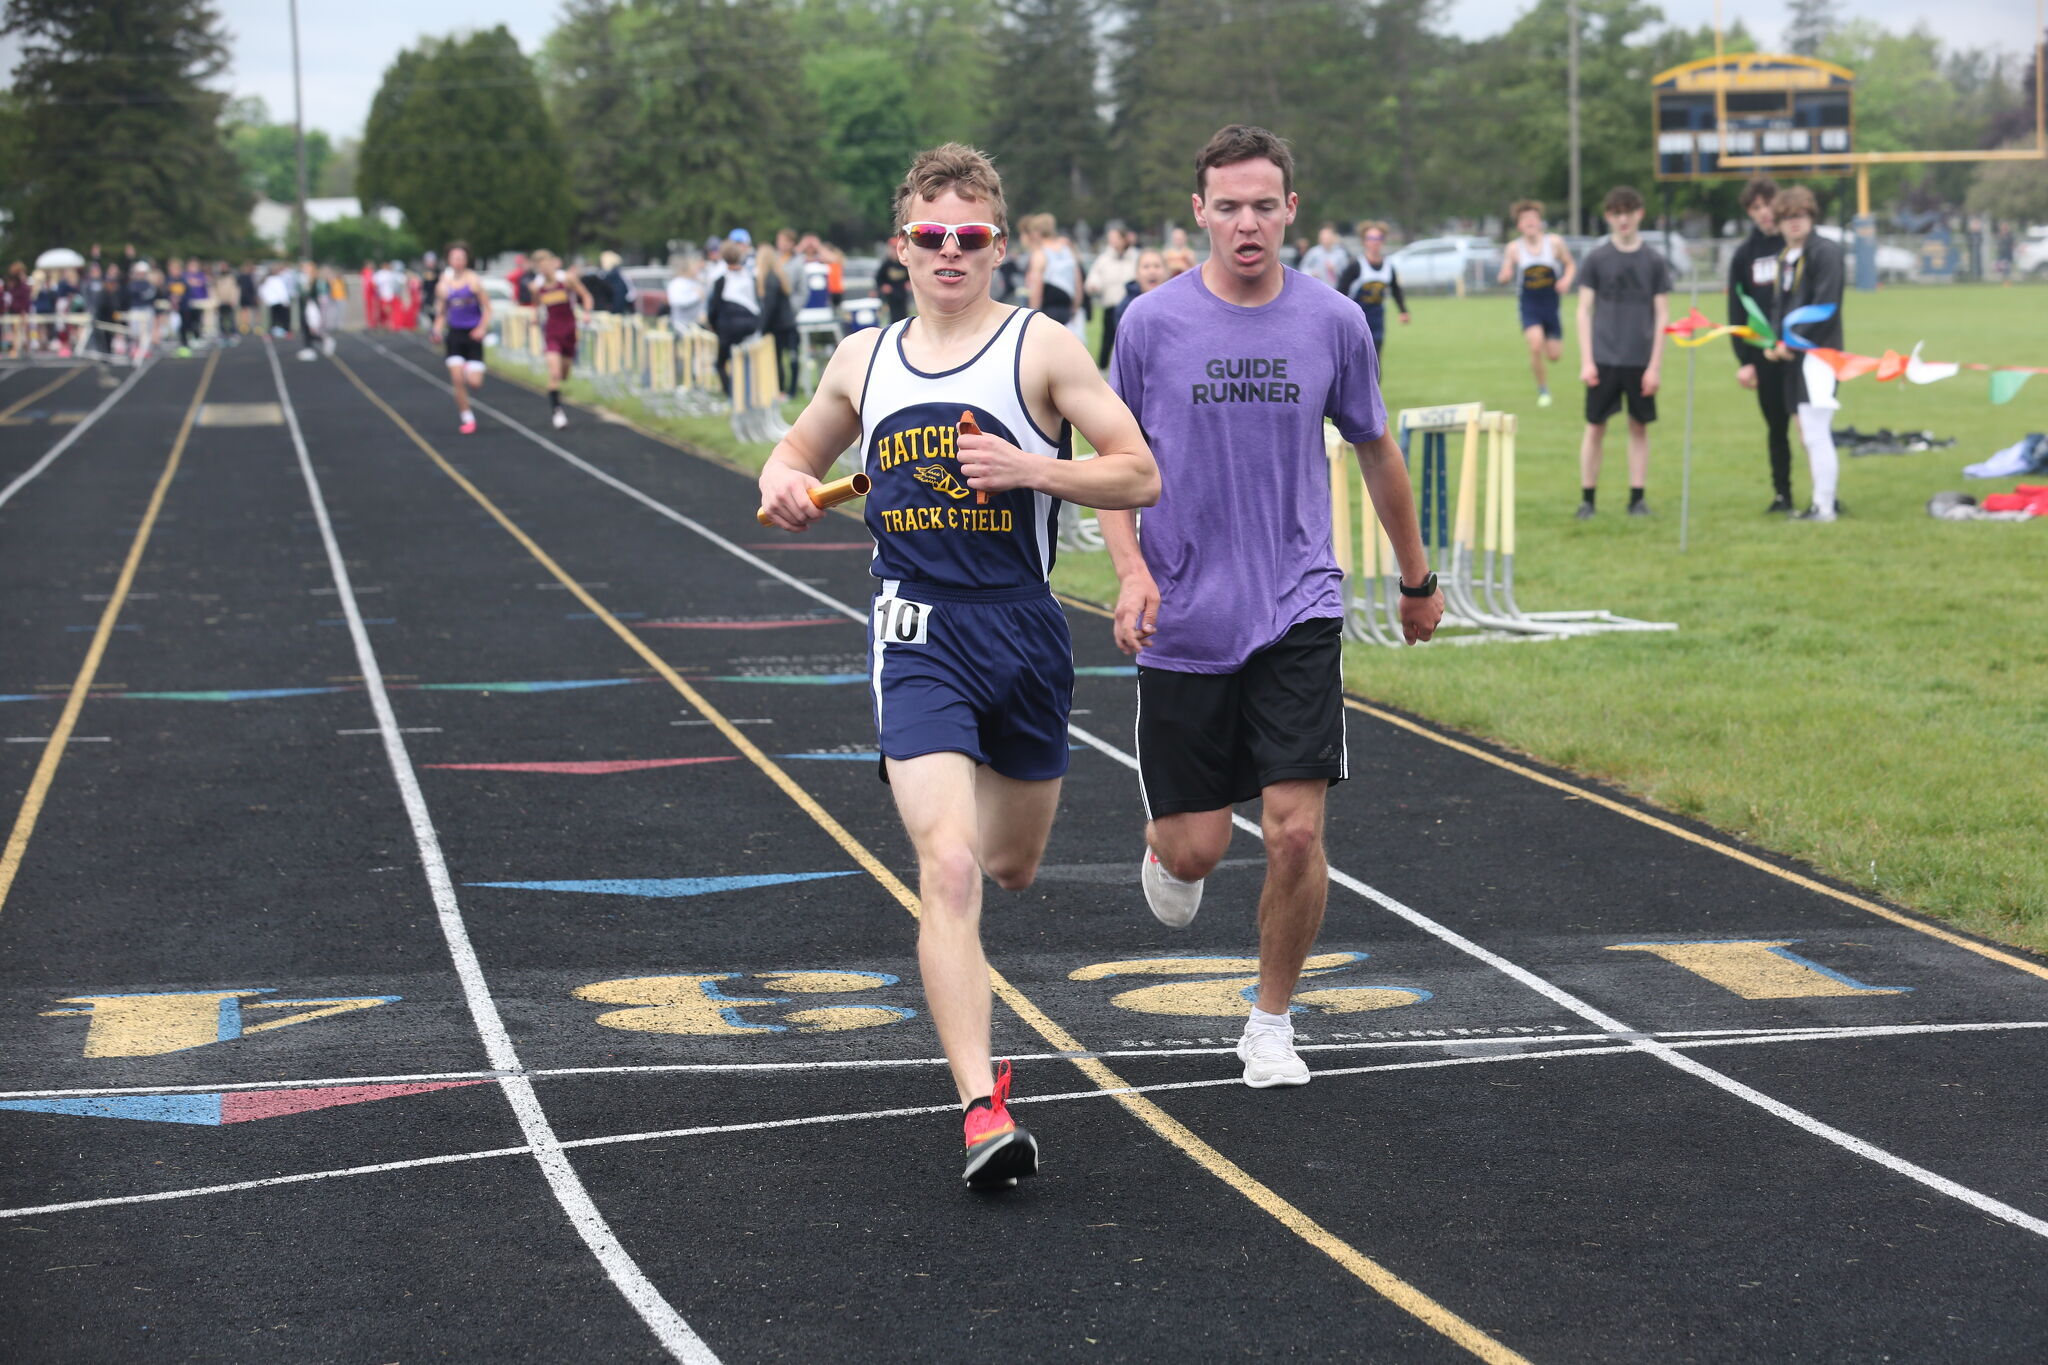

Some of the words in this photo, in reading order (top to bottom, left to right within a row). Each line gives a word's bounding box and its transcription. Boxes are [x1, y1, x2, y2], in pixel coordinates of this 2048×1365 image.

[1206, 358, 1288, 380] GUIDE
[1192, 382, 1301, 405] RUNNER
[878, 425, 960, 472] HATCH
[881, 507, 945, 533] TRACK
[948, 507, 959, 529] &
[961, 509, 1013, 533] FIELD
[875, 599, 921, 643] 10
